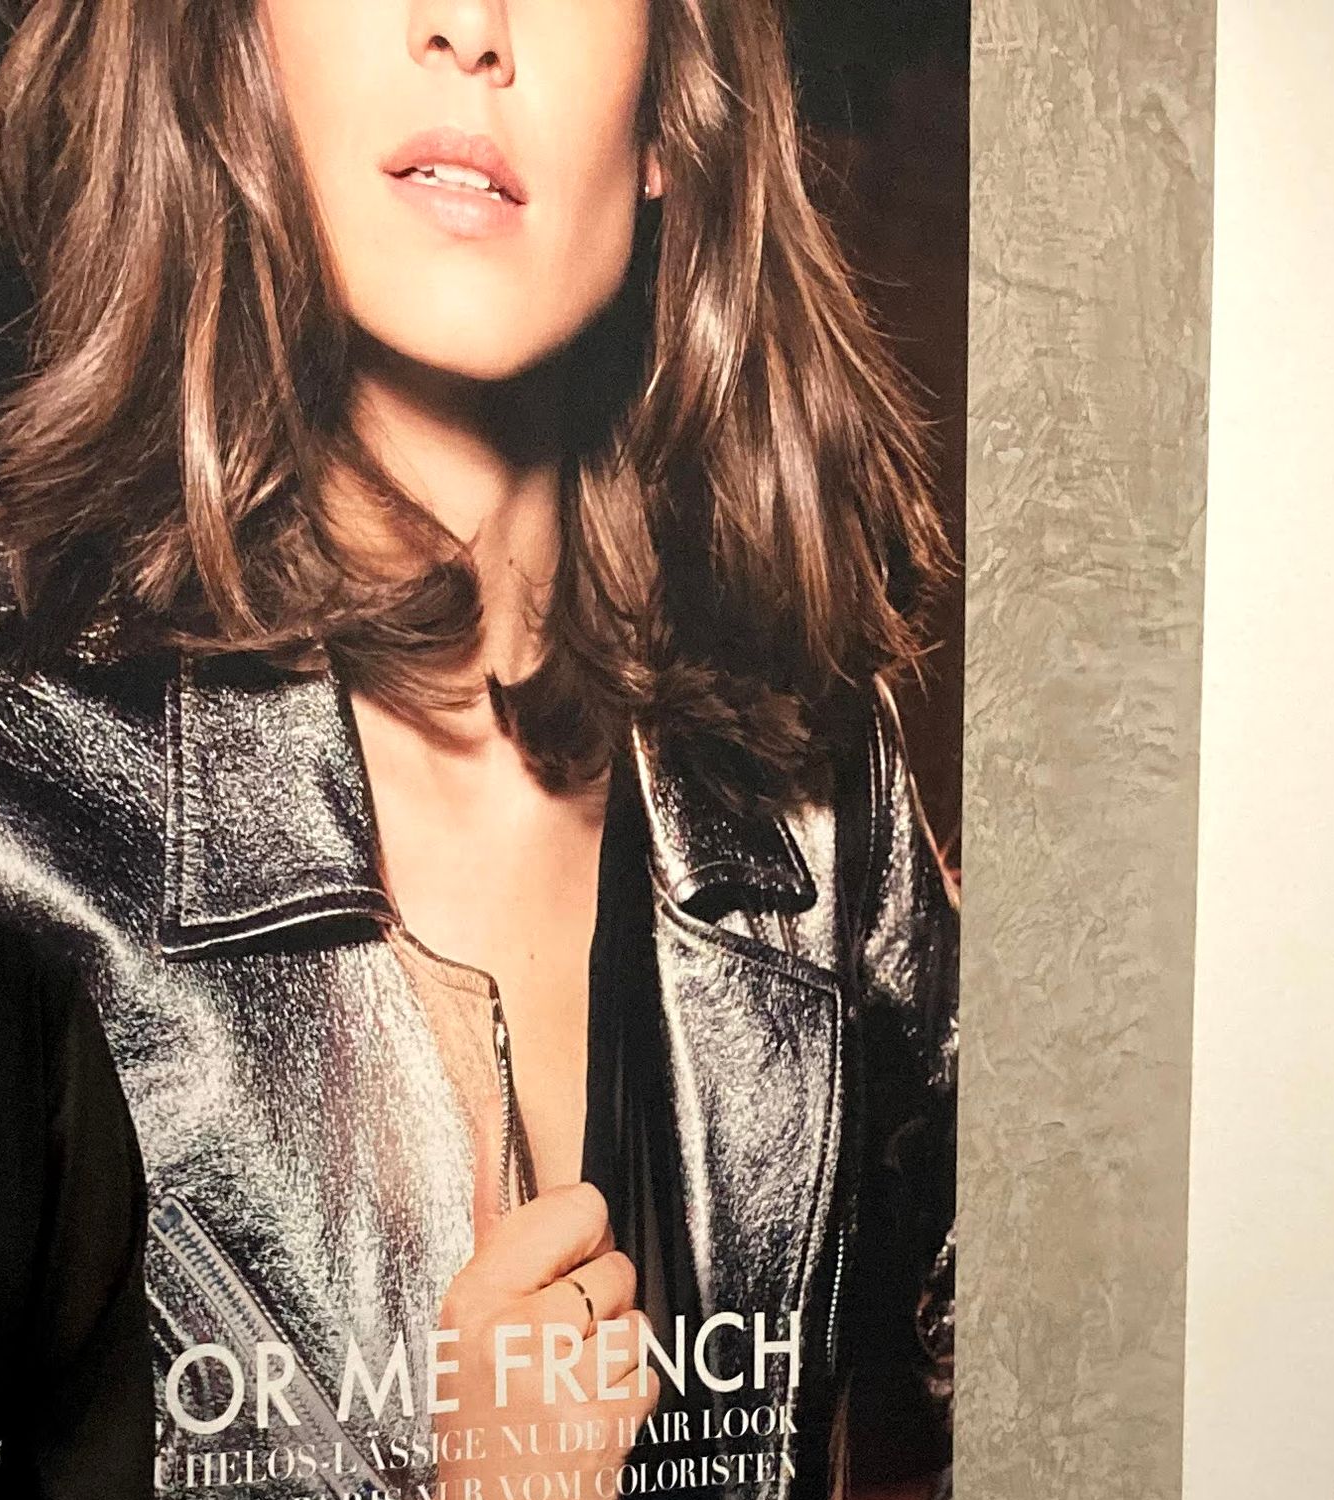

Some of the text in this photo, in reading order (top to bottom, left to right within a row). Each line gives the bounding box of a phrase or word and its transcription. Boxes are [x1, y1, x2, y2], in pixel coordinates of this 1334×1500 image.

[157, 1311, 800, 1434] OR ME FRENCH
[501, 1418, 606, 1457] NUDE
[618, 1410, 691, 1449] HAIR
[701, 1404, 799, 1440] LOOK
[594, 1449, 799, 1499] COLORISTEN
